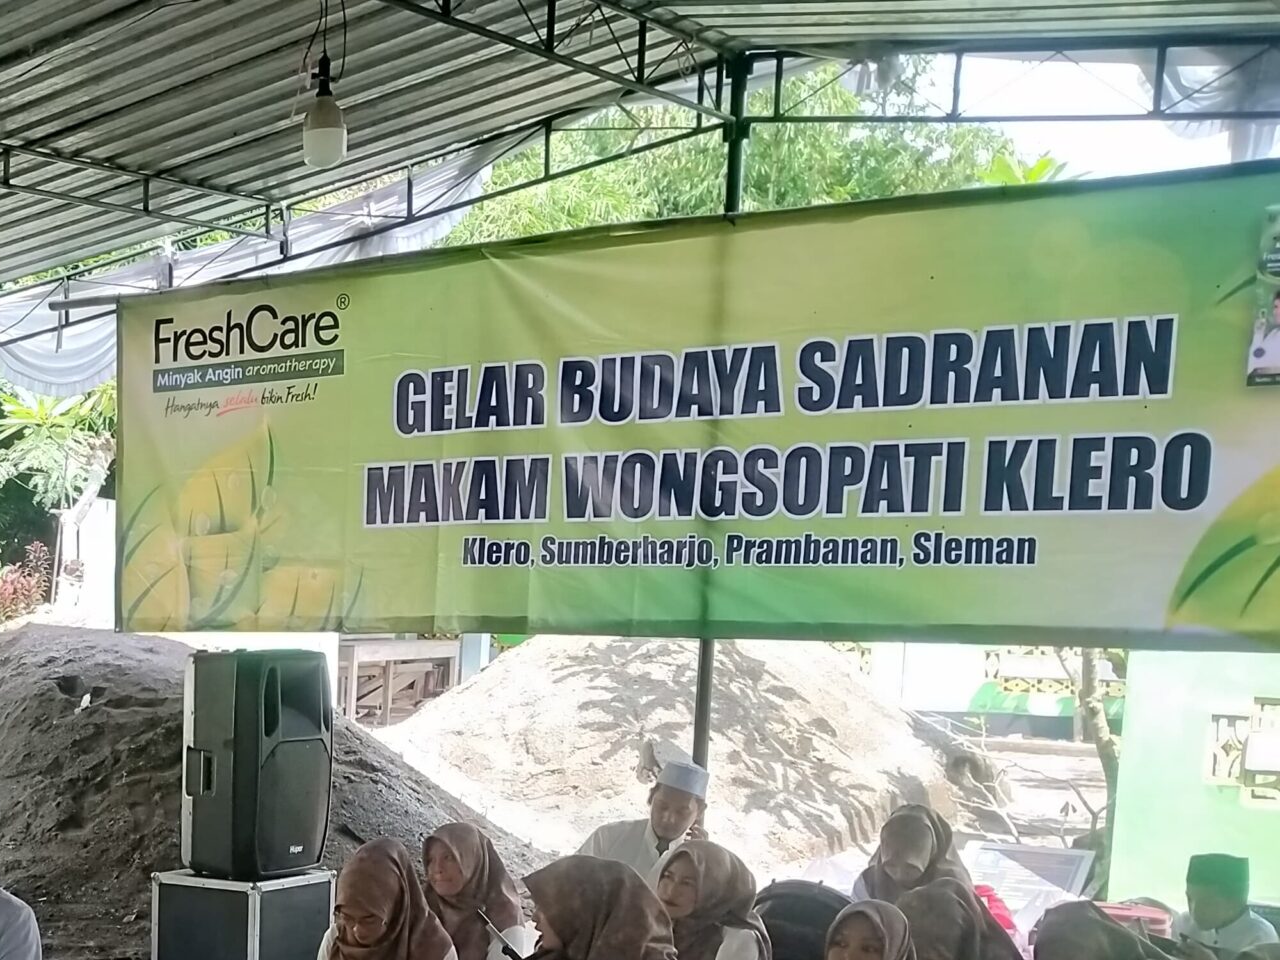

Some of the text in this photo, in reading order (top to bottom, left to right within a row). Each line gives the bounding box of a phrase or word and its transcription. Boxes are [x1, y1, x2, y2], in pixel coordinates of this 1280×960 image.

[154, 304, 340, 364] FreshCare
[156, 357, 337, 388] Minyak Angin aromatherapy
[395, 316, 1178, 435] GELAR BUDAYA SADRANAN
[165, 395, 220, 418] Hangatnya
[261, 388, 283, 405] bikin
[283, 383, 318, 404] Fresh!
[366, 432, 1213, 526] MAKAM WONGSOPATI KLERO
[462, 532, 1038, 569] Klero, Sumberharjo, Prambanan, Sleman
